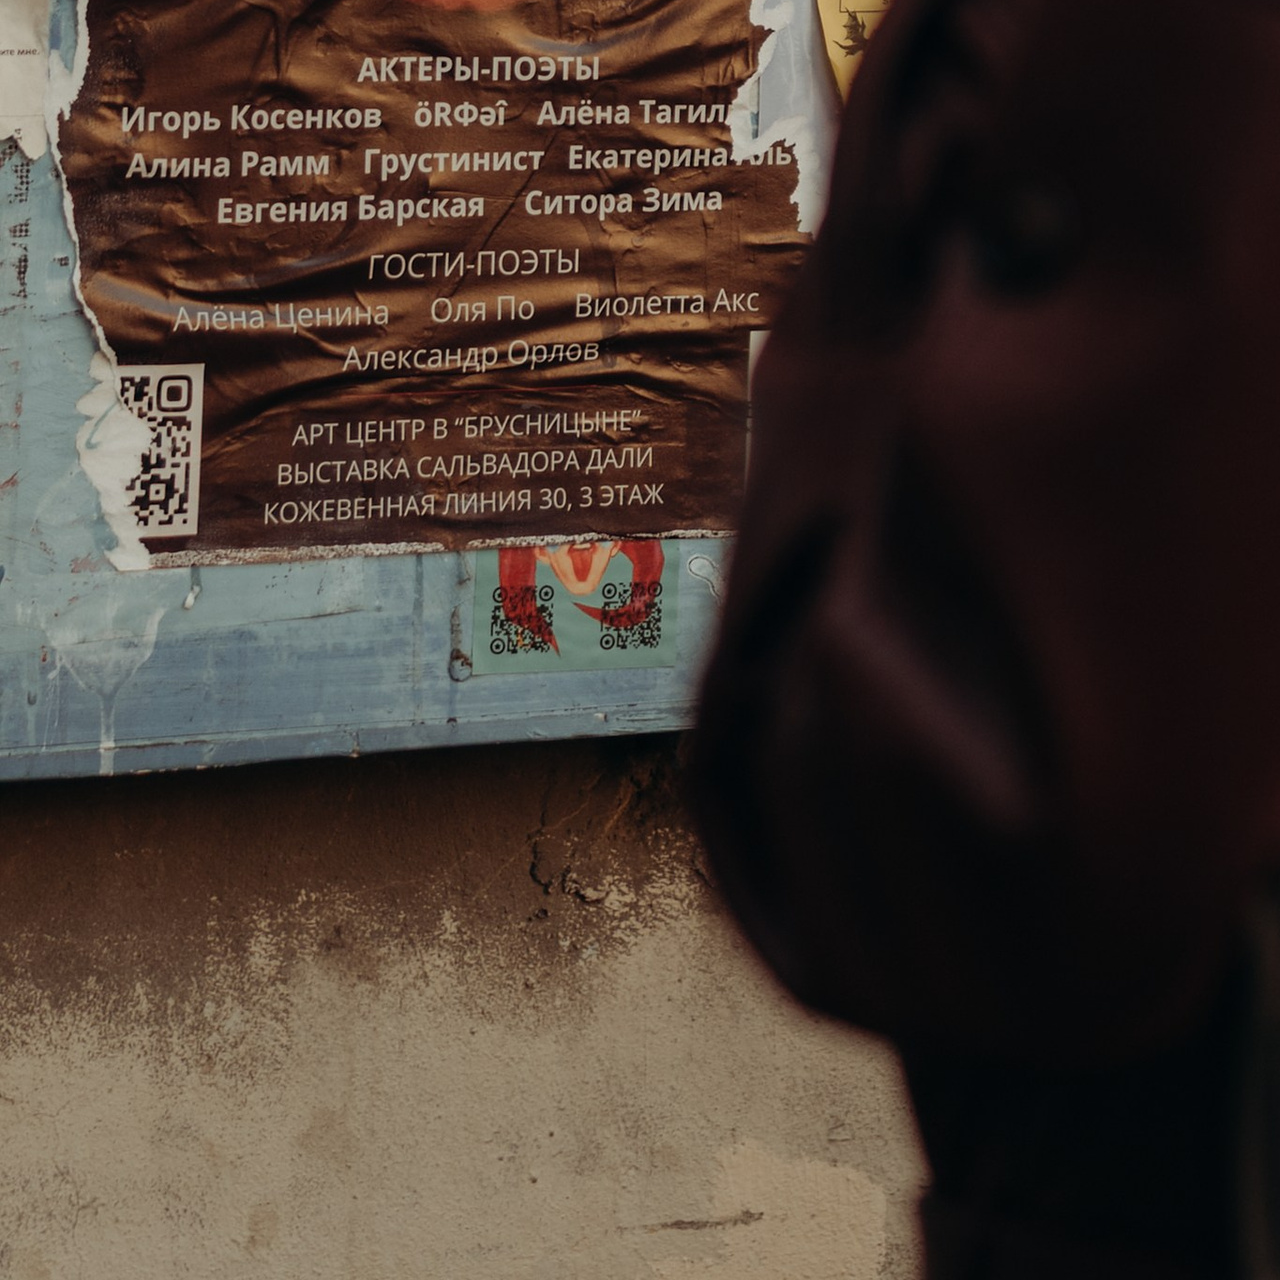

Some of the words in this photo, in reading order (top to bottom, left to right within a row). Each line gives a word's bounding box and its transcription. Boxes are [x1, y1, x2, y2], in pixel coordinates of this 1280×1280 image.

[357, 55, 600, 83] АКТЕРЫ-ПОЭТЫ
[121, 106, 221, 139] Игорь
[231, 104, 382, 131] Косенков
[536, 99, 630, 127] Алёна
[125, 152, 230, 179] Алина
[241, 150, 330, 177] Рамм
[364, 147, 545, 182] Грустинист
[568, 145, 728, 175] Екатерина
[217, 197, 348, 225] Евгения
[358, 194, 484, 227] Барская
[525, 189, 633, 220] Ситора
[642, 187, 723, 213] Зима
[368, 248, 580, 280] ГОСТИ-ПОЭТЫ
[173, 305, 265, 332] Алёна
[275, 303, 390, 334] Ценина
[430, 297, 487, 324] Оля
[497, 295, 535, 321] По
[575, 293, 704, 318] Виолетта
[713, 288, 760, 313] Акс
[342, 346, 498, 374] Александр
[507, 340, 600, 370] Орлов
[292, 422, 339, 447] АРТ
[346, 418, 426, 448] ЦЕНТР
[433, 417, 448, 440] В
[277, 457, 410, 486] ВЫСТАВКА
[416, 449, 581, 478] САЛЬВАДОРА
[585, 446, 653, 475] ДАЛИ
[263, 493, 436, 526] КОЖЕВЕННАЯ
[442, 488, 532, 516] ЛИНИЯ
[538, 486, 573, 513] 30,
[579, 485, 594, 508] 3
[599, 482, 665, 507] ЭТАЖ
